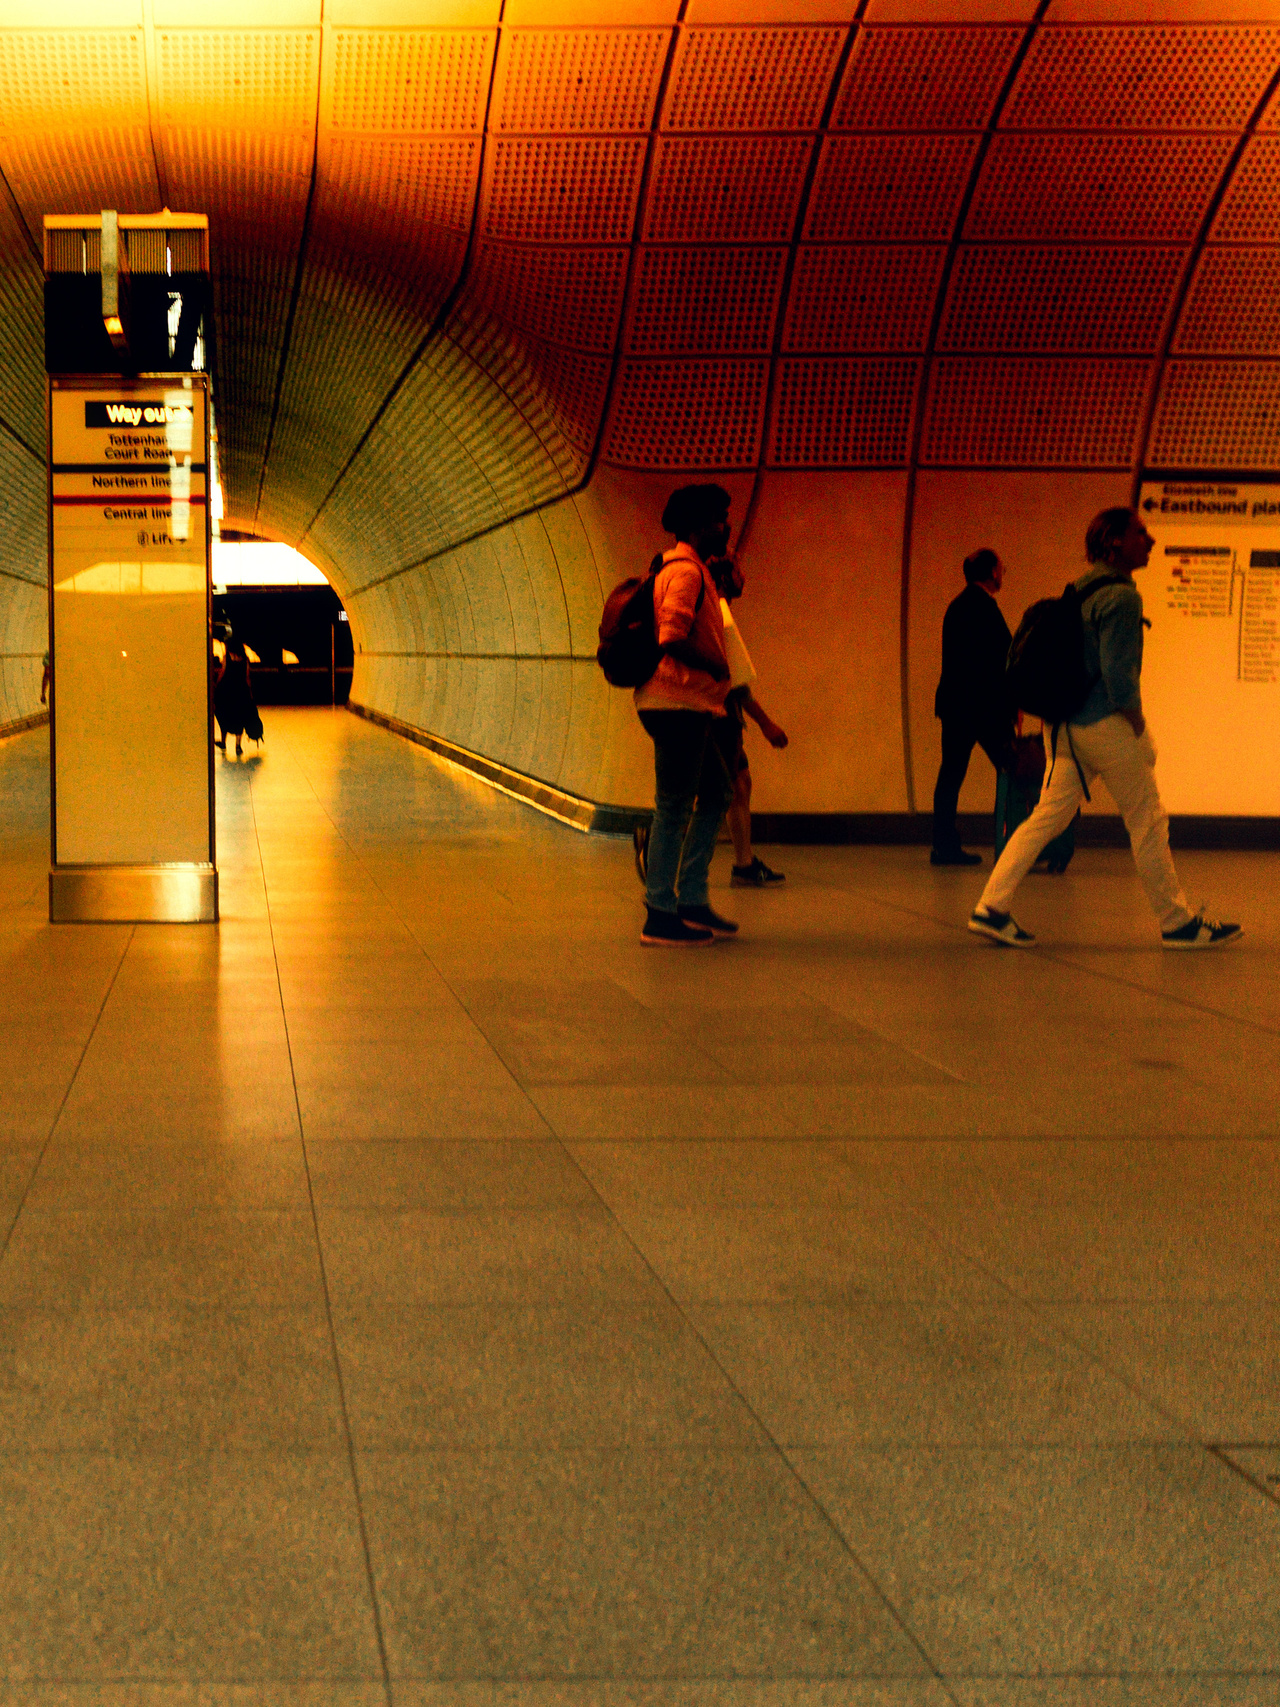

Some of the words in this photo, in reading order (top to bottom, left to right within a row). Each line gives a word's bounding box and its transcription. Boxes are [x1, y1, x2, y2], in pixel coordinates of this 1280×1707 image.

[106, 404, 142, 426] Way
[143, 405, 174, 423] out
[105, 447, 140, 460] Court
[143, 447, 173, 460] Road
[92, 475, 148, 488] Northern
[151, 475, 173, 488] line
[1160, 498, 1248, 514] Eastbound
[103, 507, 148, 520] Central
[151, 507, 173, 520] line
